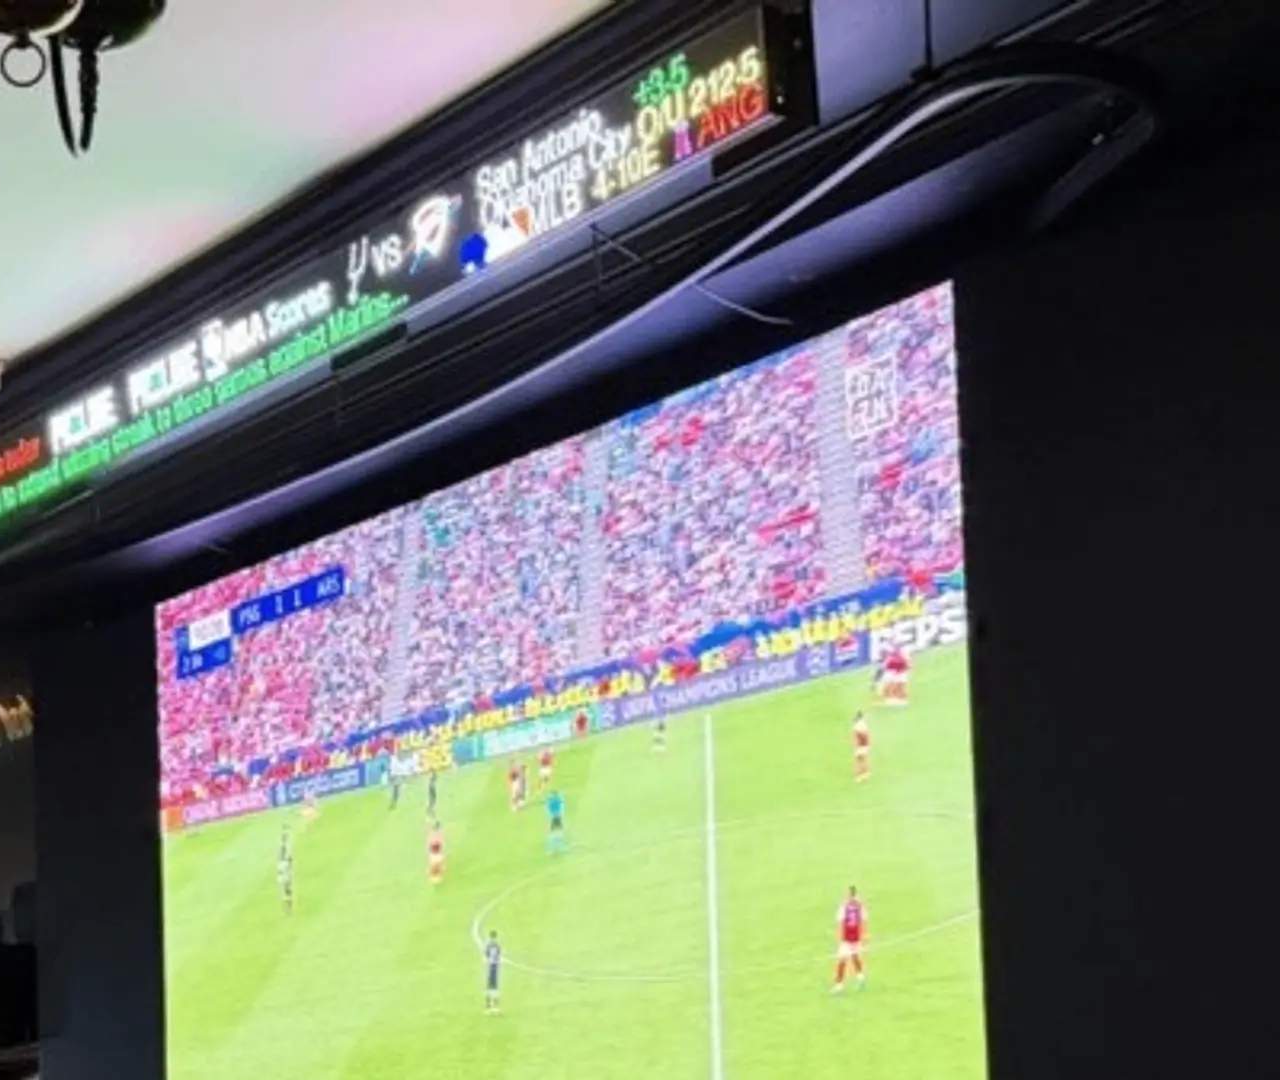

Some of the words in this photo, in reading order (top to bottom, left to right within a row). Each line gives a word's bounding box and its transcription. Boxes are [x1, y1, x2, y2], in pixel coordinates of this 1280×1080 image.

[635, 54, 688, 107] +3.5
[638, 91, 682, 141] O/U
[688, 46, 759, 116] 212.5
[478, 156, 516, 199] San
[524, 107, 602, 173] Antonio
[589, 117, 631, 170] City
[268, 281, 331, 339] Scores
